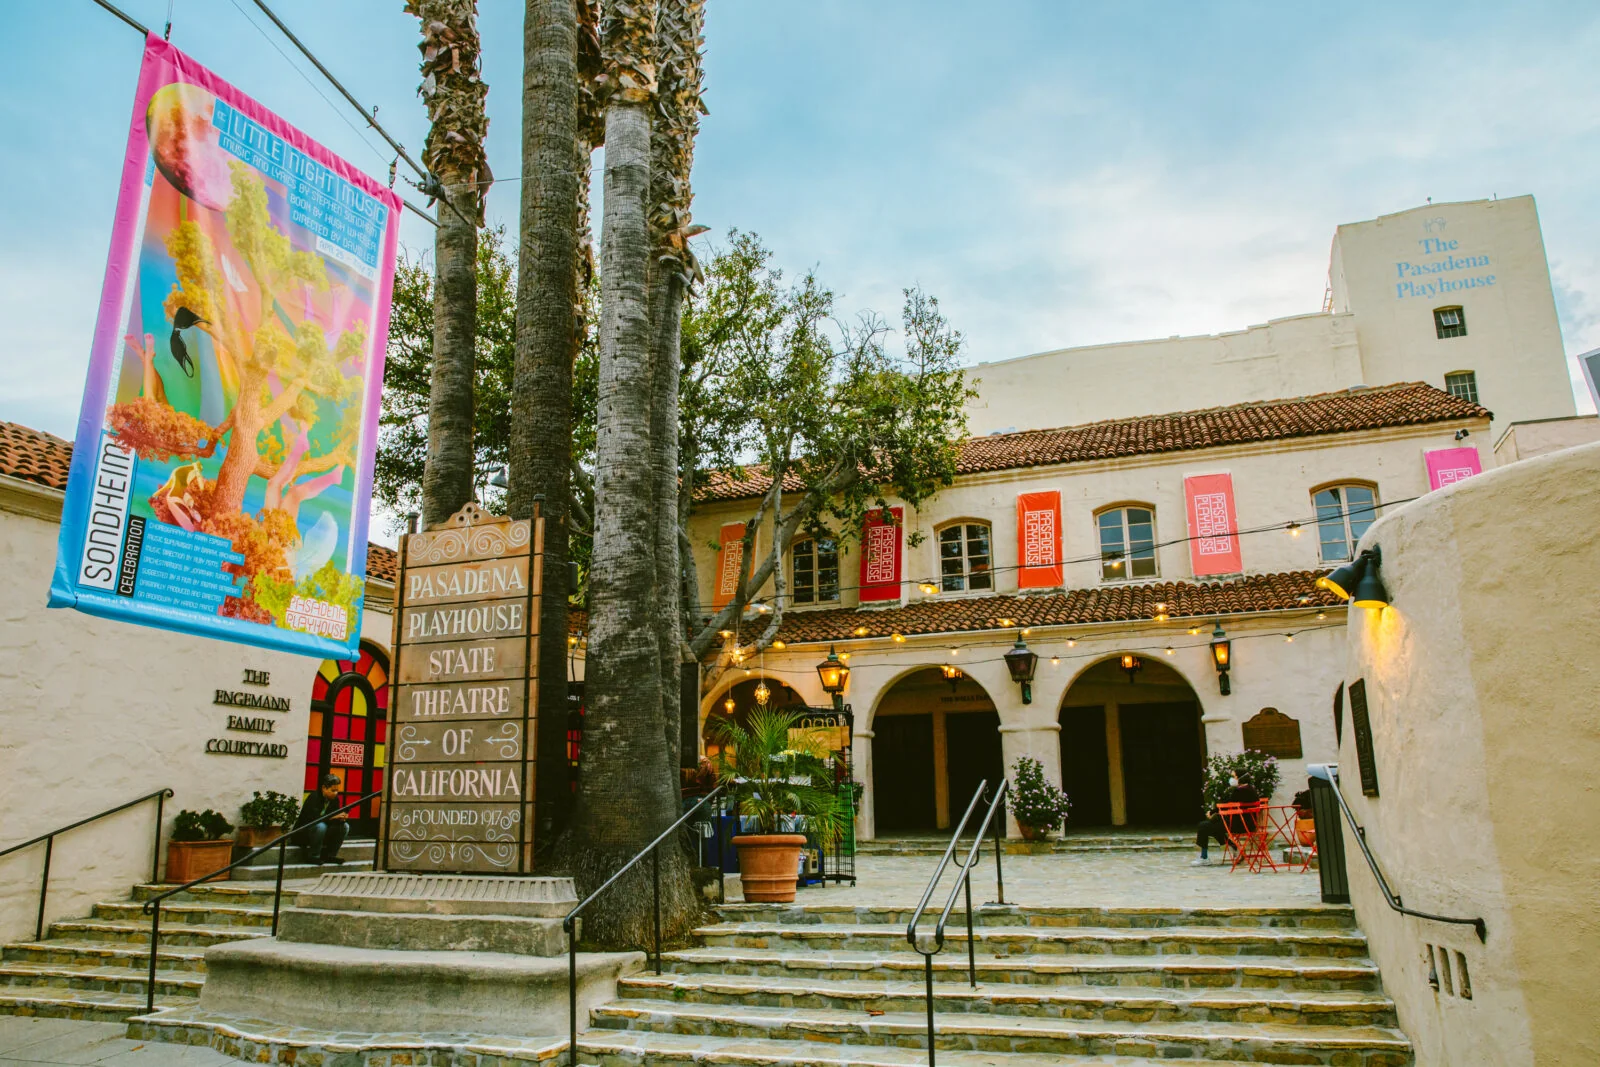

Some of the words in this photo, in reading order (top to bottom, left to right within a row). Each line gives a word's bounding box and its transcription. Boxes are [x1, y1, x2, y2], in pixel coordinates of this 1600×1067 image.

[222, 136, 250, 161] MUSIC
[252, 154, 269, 172] AND
[272, 166, 296, 190] LYRICS
[299, 184, 310, 195] BY
[312, 190, 342, 216] STEPHEN
[234, 116, 282, 161] LITTLE
[288, 148, 334, 192] NIGHT
[342, 184, 386, 226] MUSIC
[290, 194, 312, 212] BOOK
[312, 206, 322, 218] BY
[292, 210, 328, 236] DIRECTED
[330, 231, 340, 242] BY
[1418, 238, 1458, 254] The
[1396, 255, 1490, 278] Pasadena
[1396, 274, 1496, 299] Playhouse
[84, 442, 130, 582] SONDHEIM
[1211, 496, 1229, 551] PASADENA
[1028, 512, 1039, 566] PLAYHOUSE
[1041, 511, 1053, 565] PASADENA
[120, 519, 144, 594] CELEBRATION
[882, 526, 894, 580] PASADENA
[408, 564, 525, 600] PASADENA
[290, 596, 346, 619] PASADENA
[409, 604, 522, 638] PLAYHOUSE
[286, 613, 346, 638] PLAYHOUSE
[429, 647, 495, 676] STATE
[243, 668, 270, 686] THE
[214, 690, 290, 711] ENGEMANN
[412, 686, 510, 716] THEATRE
[227, 715, 276, 733] FAMILY
[205, 739, 288, 758] COURTYARD
[442, 728, 474, 756] OF
[392, 768, 520, 801] CALIFORNIA
[412, 809, 478, 826] FOUNDED
[481, 808, 502, 826] 1917
